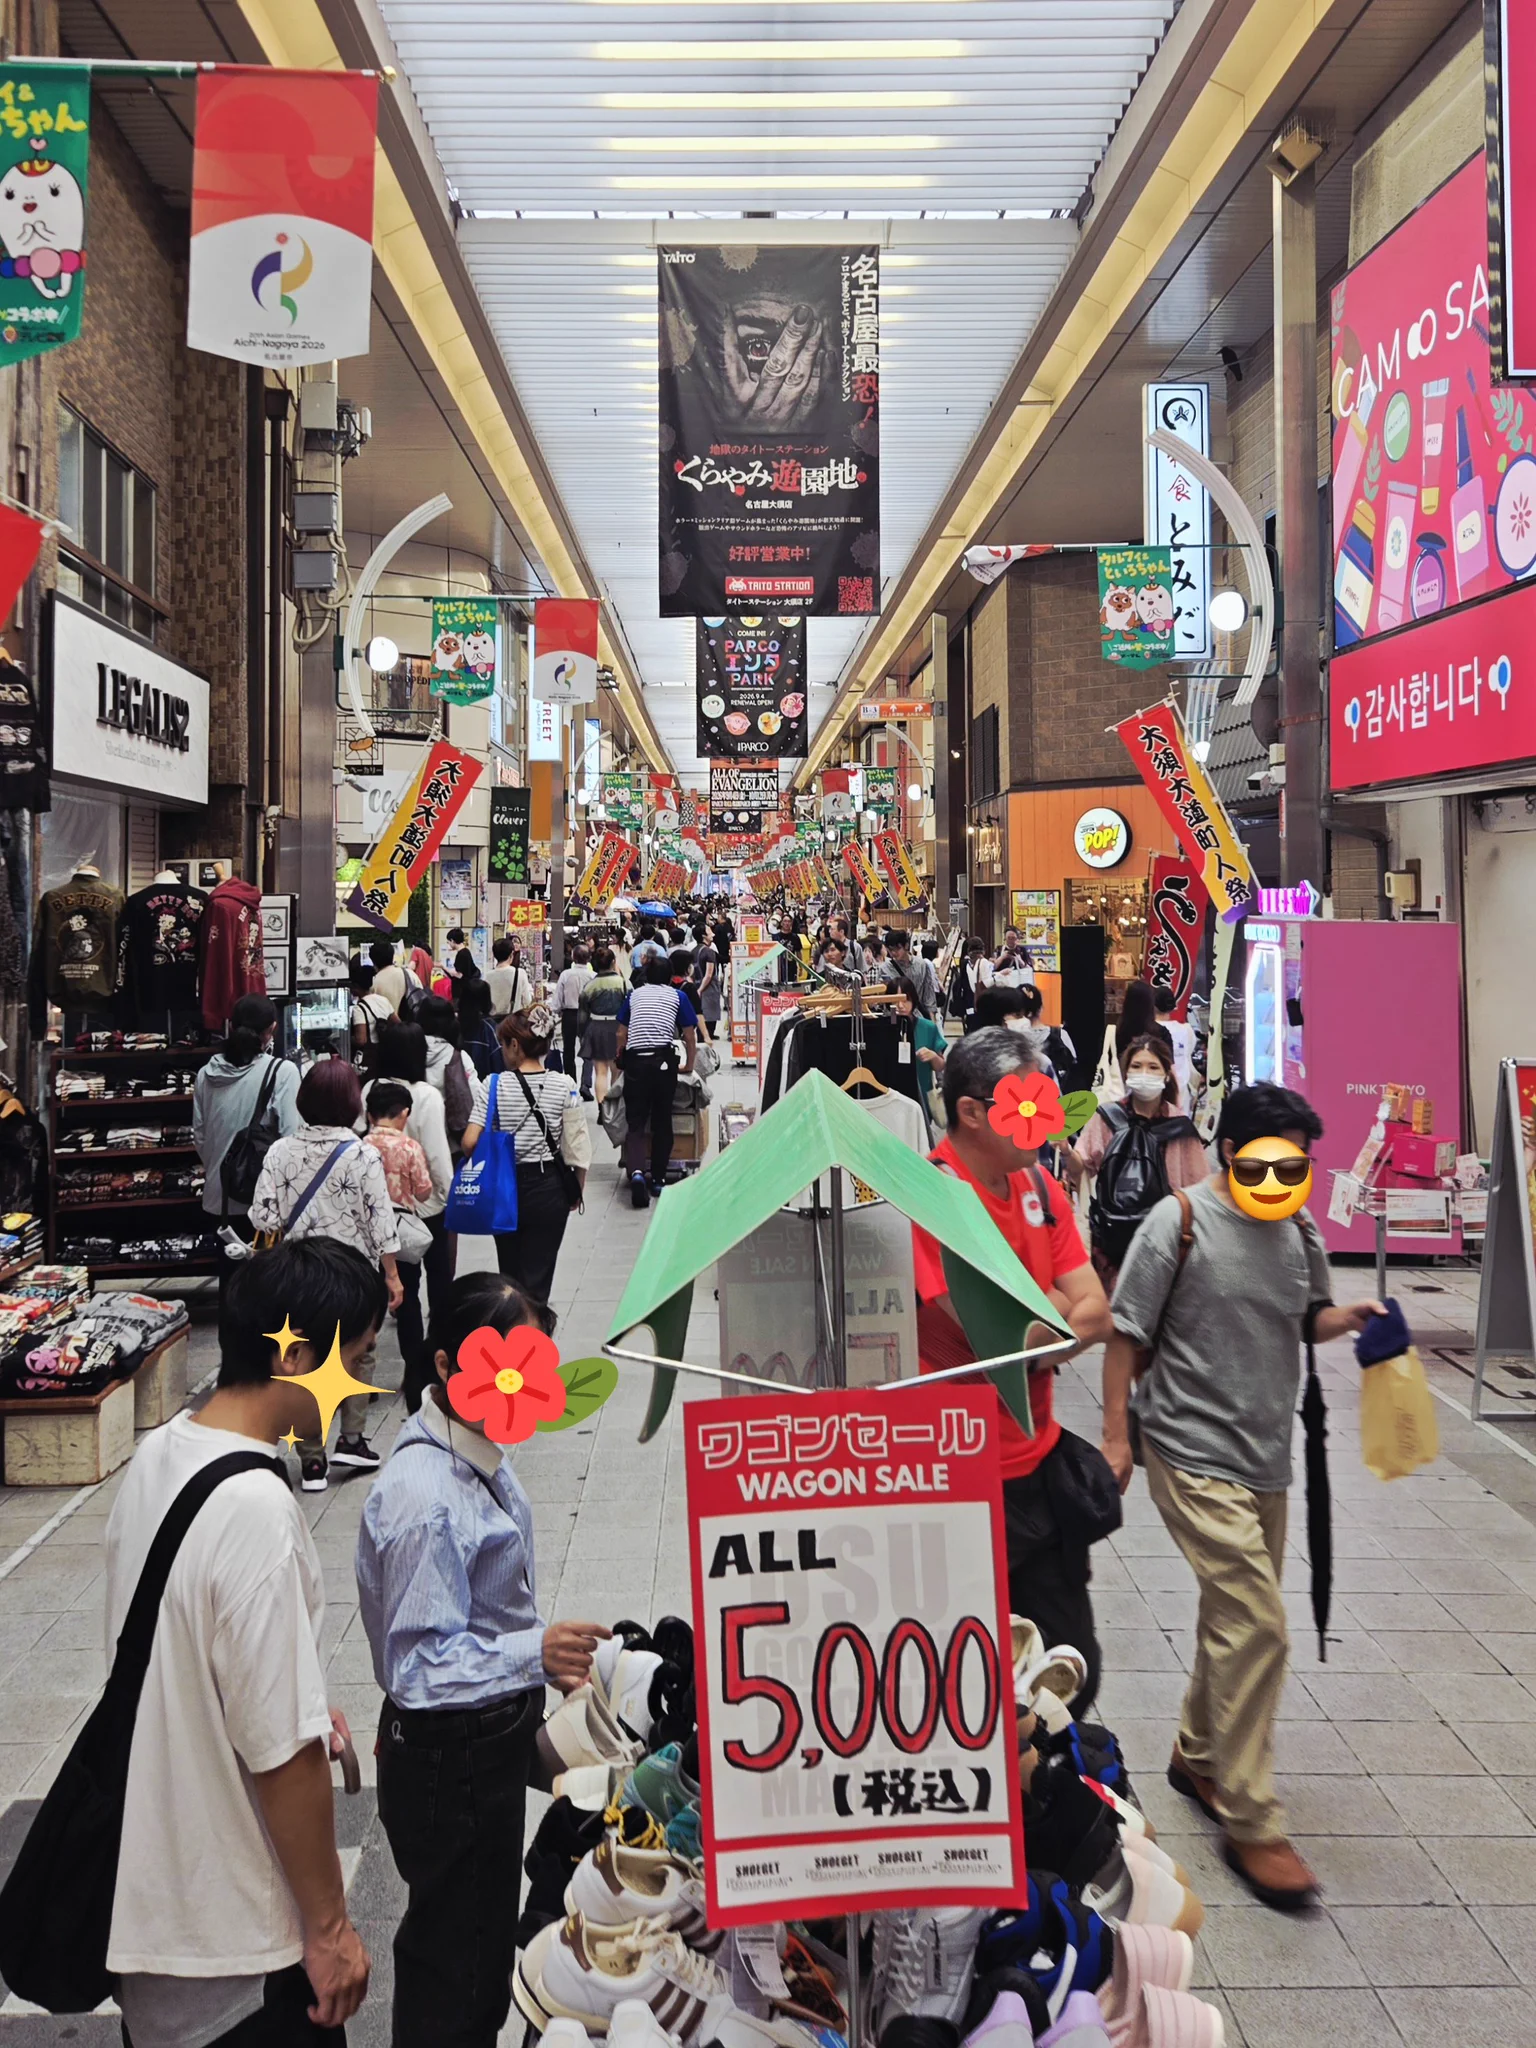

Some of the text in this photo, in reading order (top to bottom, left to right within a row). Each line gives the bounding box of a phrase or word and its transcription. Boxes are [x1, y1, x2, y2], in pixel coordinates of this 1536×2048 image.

[0, 102, 88, 139] ちゃん
[234, 338, 326, 350] Aichi-Nagoya 2026
[677, 455, 860, 496] くらやみ遊園地
[747, 580, 811, 591] TAITO STATION
[724, 640, 780, 653] PARCO
[730, 673, 775, 685] PARK
[1365, 655, 1483, 739] 감사합니다
[711, 768, 729, 778] ALL
[729, 768, 741, 778] OF
[711, 778, 778, 791] EVANGELION
[492, 813, 528, 826] Clover
[1139, 724, 1253, 906] 大須大道町人祭
[1083, 824, 1121, 854] POP!
[50, 892, 114, 913] BETTY
[146, 894, 183, 910] BETTY
[1346, 1083, 1426, 1096] PINK TYO
[454, 1182, 481, 1195] adidas
[697, 1408, 987, 1470] ワゴンセール
[736, 1463, 949, 1502] WAGON SALE
[708, 1528, 836, 1579] ALL
[719, 1600, 1000, 1773] 5,000
